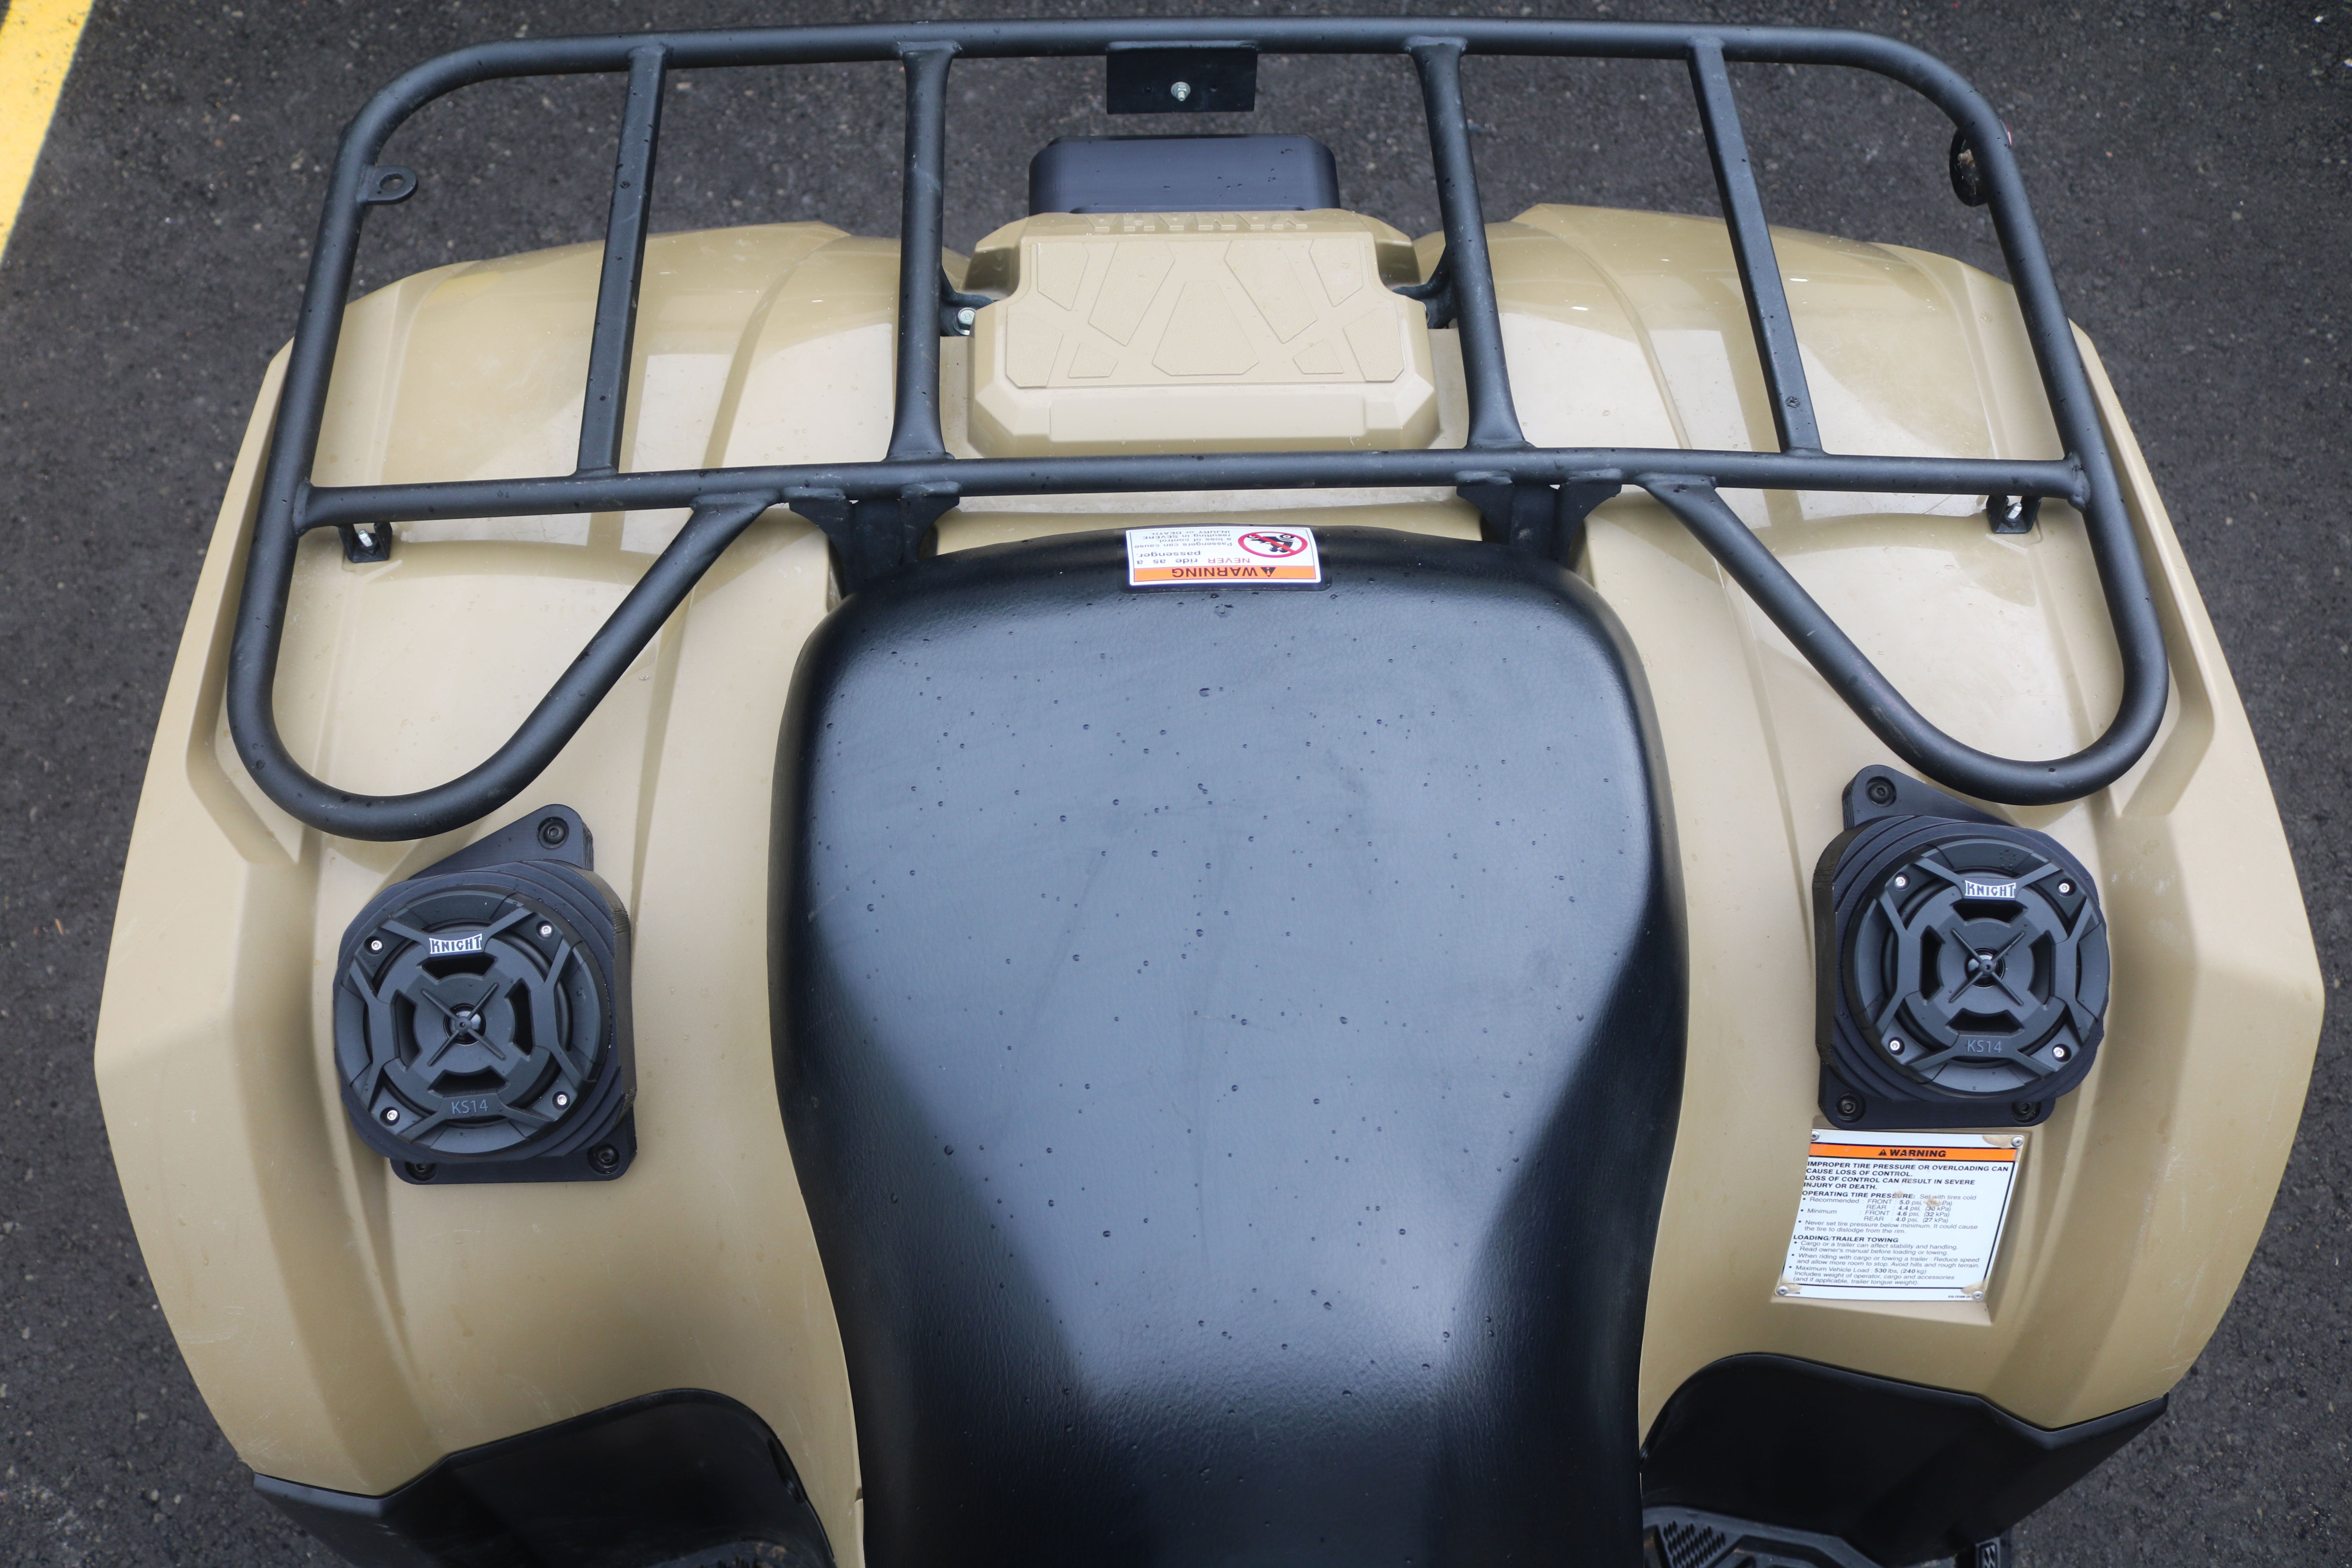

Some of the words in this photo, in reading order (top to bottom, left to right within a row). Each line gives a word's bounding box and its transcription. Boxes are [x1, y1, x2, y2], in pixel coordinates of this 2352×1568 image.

[1086, 212, 1307, 232] YAMAHA
[1172, 567, 1258, 577] WARNING
[1967, 882, 2014, 897] KNIGHT
[432, 935, 481, 953] KNIGHT
[1967, 1040, 2002, 1053] KS14
[452, 1100, 488, 1114] KS14
